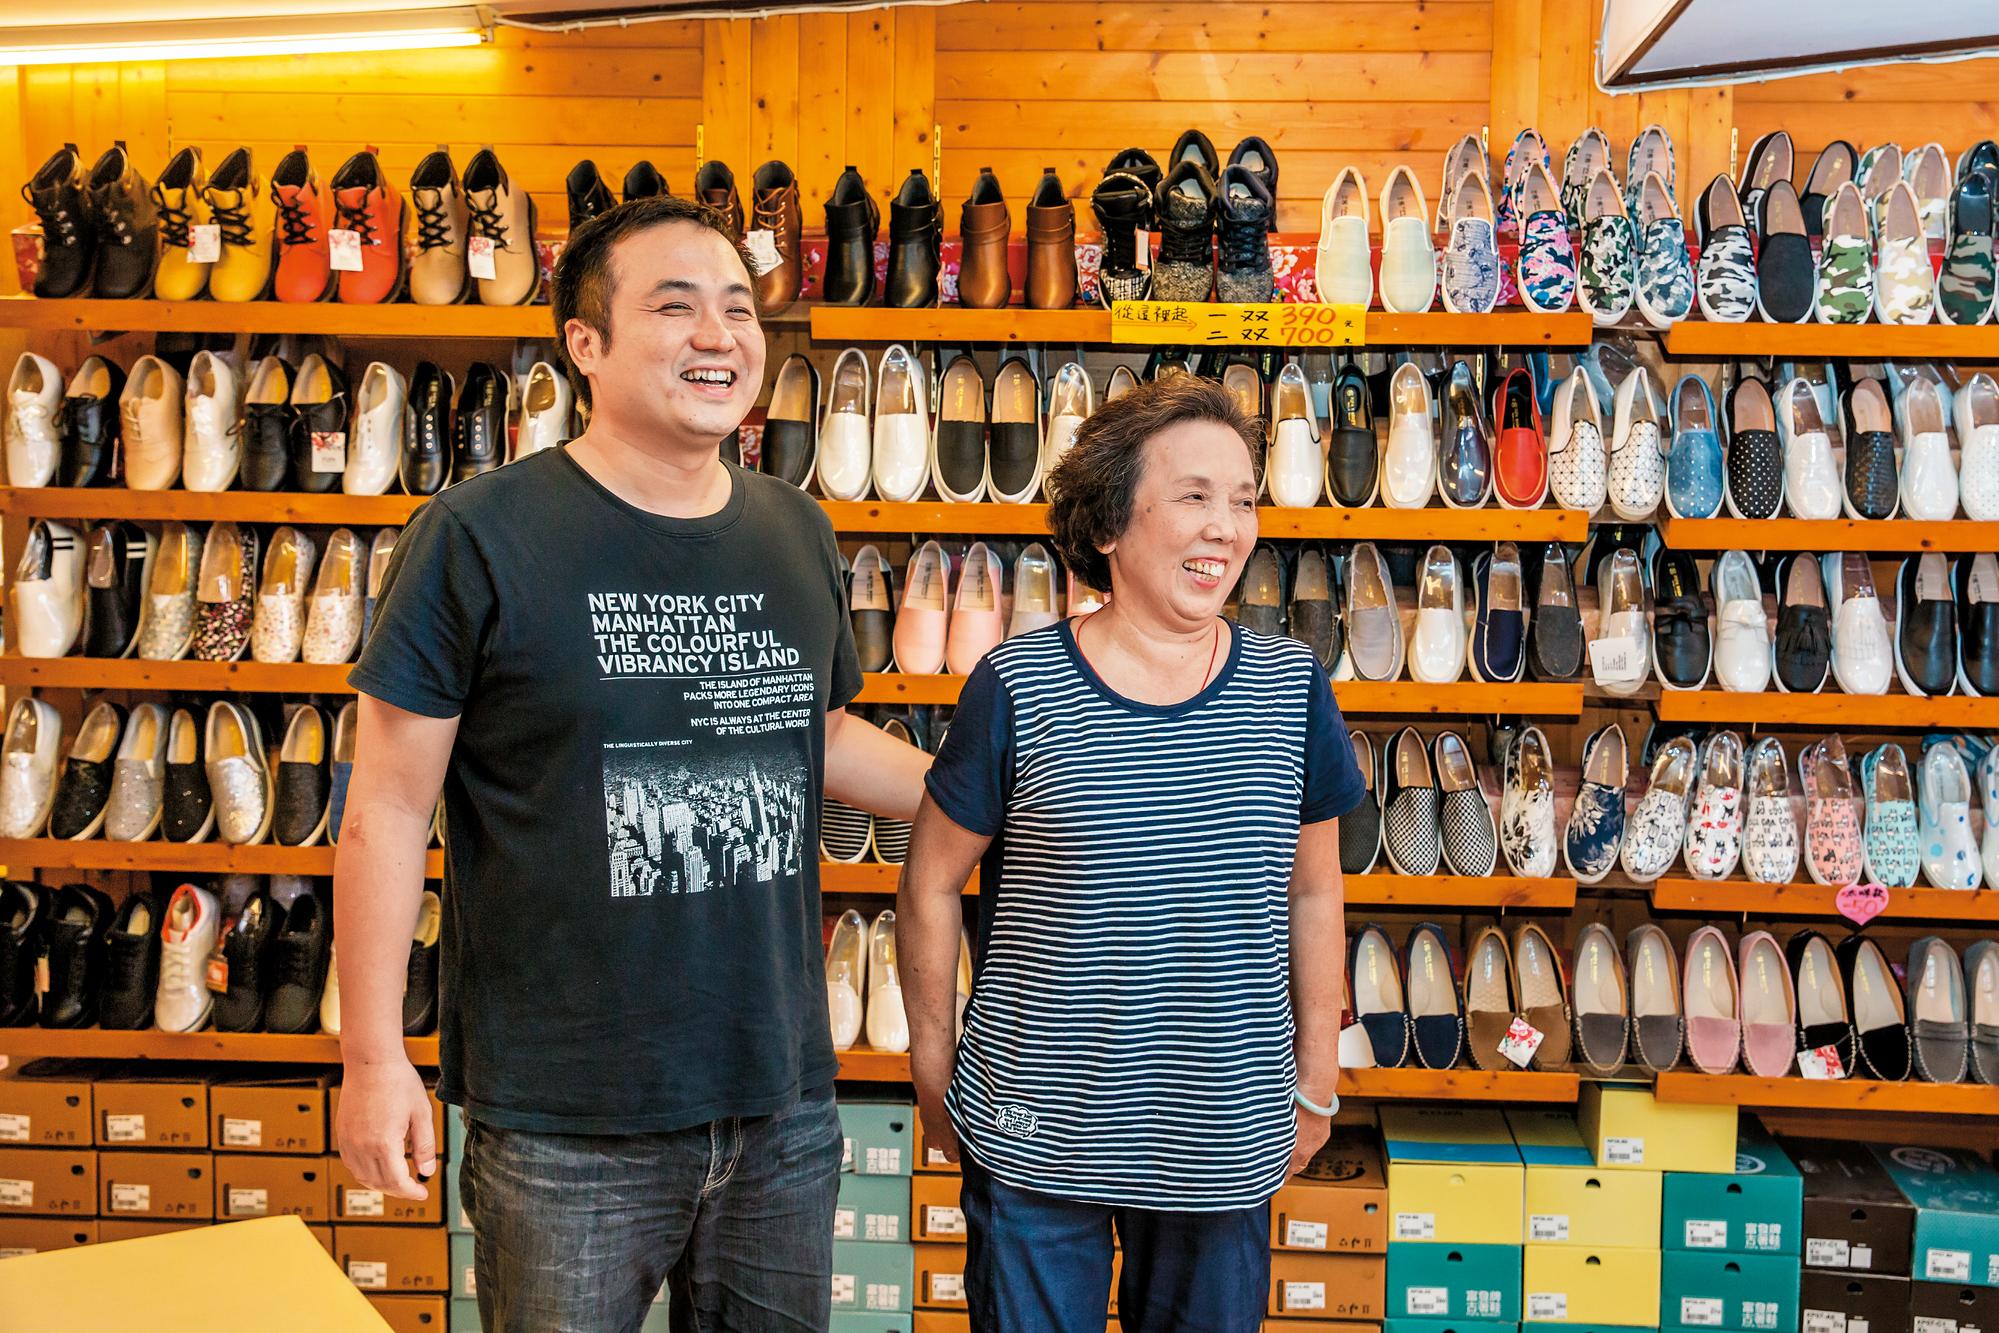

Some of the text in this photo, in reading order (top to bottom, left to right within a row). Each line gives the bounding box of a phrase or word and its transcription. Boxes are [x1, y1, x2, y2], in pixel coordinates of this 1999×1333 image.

[1281, 305, 1336, 325] 390
[1280, 327, 1334, 345] 700
[587, 593, 765, 614] NEW YORK CITY
[592, 614, 736, 633] MANHATTAN
[594, 629, 781, 653] THE COLOURFUL
[597, 648, 800, 674] VIBRANCY ISLAND
[700, 673, 813, 690] THE ISLAND OF MANHATTAN
[683, 683, 814, 701] PACKS MORE LEGENDARY ICONS
[713, 693, 814, 710] INTO ONE COMPACT AREA
[690, 709, 811, 727] NYC IS ALWAYS AT THE CENTER
[716, 719, 810, 735] OF THE CULTURAL WORLD
